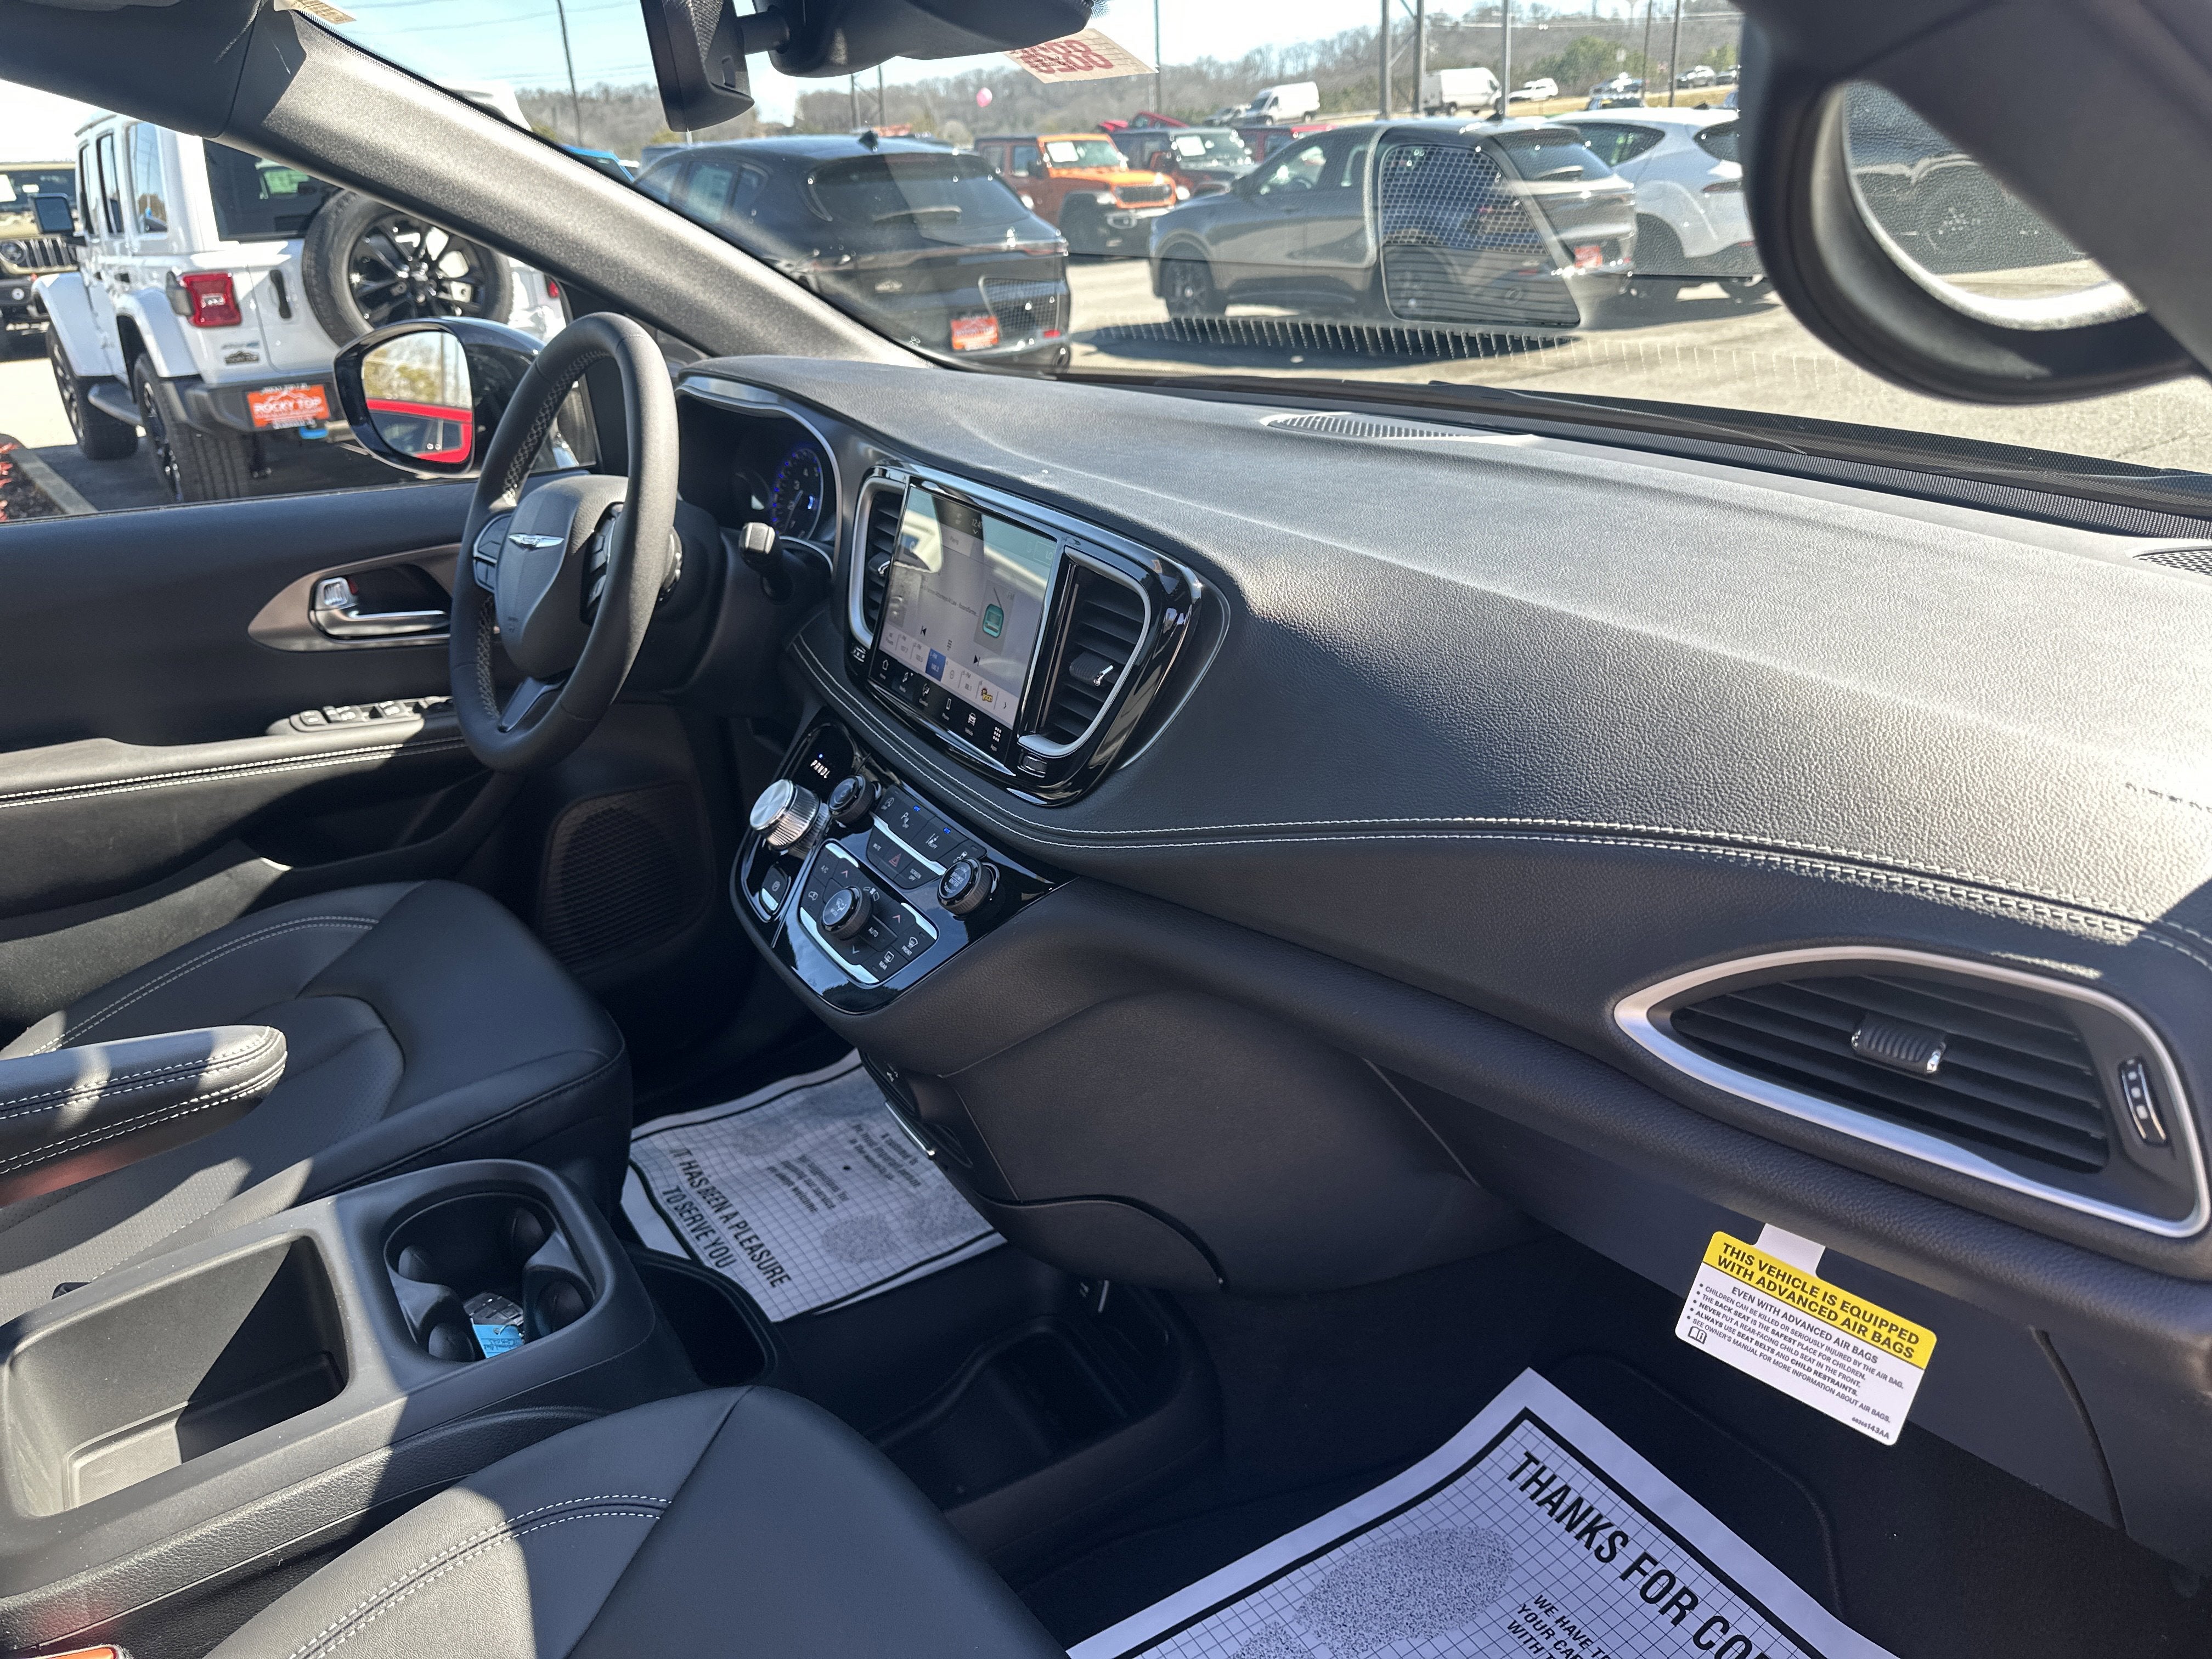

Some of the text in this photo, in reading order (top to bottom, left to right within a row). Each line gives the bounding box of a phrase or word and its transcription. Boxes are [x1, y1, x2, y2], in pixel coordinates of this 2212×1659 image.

[253, 396, 322, 414] ROCKY TOP
[868, 927, 879, 938] AUTO
[901, 945, 912, 956] FRONT
[680, 1160, 709, 1189] HAS
[697, 1185, 733, 1214] BEEN
[662, 1184, 738, 1269] TO SERVE YOU
[718, 1210, 740, 1224] A
[727, 1219, 792, 1288] PLEASURE
[1718, 1255, 1915, 1359] WITH ADVANCED AIR BAGS
[1723, 1242, 1920, 1345] THIS VEHICLE IS EQUIPPED
[1731, 1286, 1878, 1364] EVEN WITH ADVANCED AIR BAGS
[1695, 1311, 1724, 1328] ALWAYS
[1724, 1324, 1737, 1335] USE
[1736, 1331, 1754, 1344] SEAT
[1754, 1340, 1775, 1355] BELTS
[1775, 1351, 1790, 1362] AND
[1790, 1358, 1813, 1373] CHILD
[1699, 1302, 1722, 1318] NEVER
[1721, 1313, 1735, 1324] PUT
[1780, 1343, 1799, 1356] CHILD
[1799, 1353, 1816, 1364] SEAT
[1815, 1361, 1824, 1369] IN
[1825, 1364, 1838, 1376] THE
[1702, 1294, 1715, 1304] THE
[1714, 1300, 1734, 1314] BACK
[1733, 1310, 1751, 1322] SEAT
[1758, 1322, 1771, 1333] THE
[1770, 1329, 1797, 1345] SAFEST
[1797, 1341, 1818, 1356] PLACE
[1818, 1352, 1832, 1363] FOR
[1705, 1286, 1735, 1305] CHILDREN
[1735, 1301, 1749, 1312] CAN
[1749, 1307, 1758, 1317] BE
[1758, 1312, 1780, 1327] KILLED
[1780, 1323, 1790, 1333] OR
[1790, 1328, 1825, 1349] SERIOUSLY
[1825, 1345, 1852, 1363] INJURED
[1852, 1359, 1863, 1368] BY
[1863, 1363, 1876, 1375] THE
[1875, 1371, 1888, 1381] AIR
[1692, 1318, 1705, 1331] SEE
[1732, 1338, 1758, 1356] MANUAL
[1758, 1352, 1772, 1363] FOR
[1772, 1358, 1792, 1373] MORE
[1791, 1368, 1836, 1395] INFORMATION
[1835, 1391, 1859, 1406] ABOUT
[1858, 1403, 1871, 1413] AIR
[1506, 1451, 1771, 1659] THANKS FOR CO
[1506, 1620, 1545, 1655] WITH
[1517, 1604, 1556, 1641] YOUR
[1533, 1594, 1559, 1618] WE
[1555, 1615, 1595, 1650] HAVE
